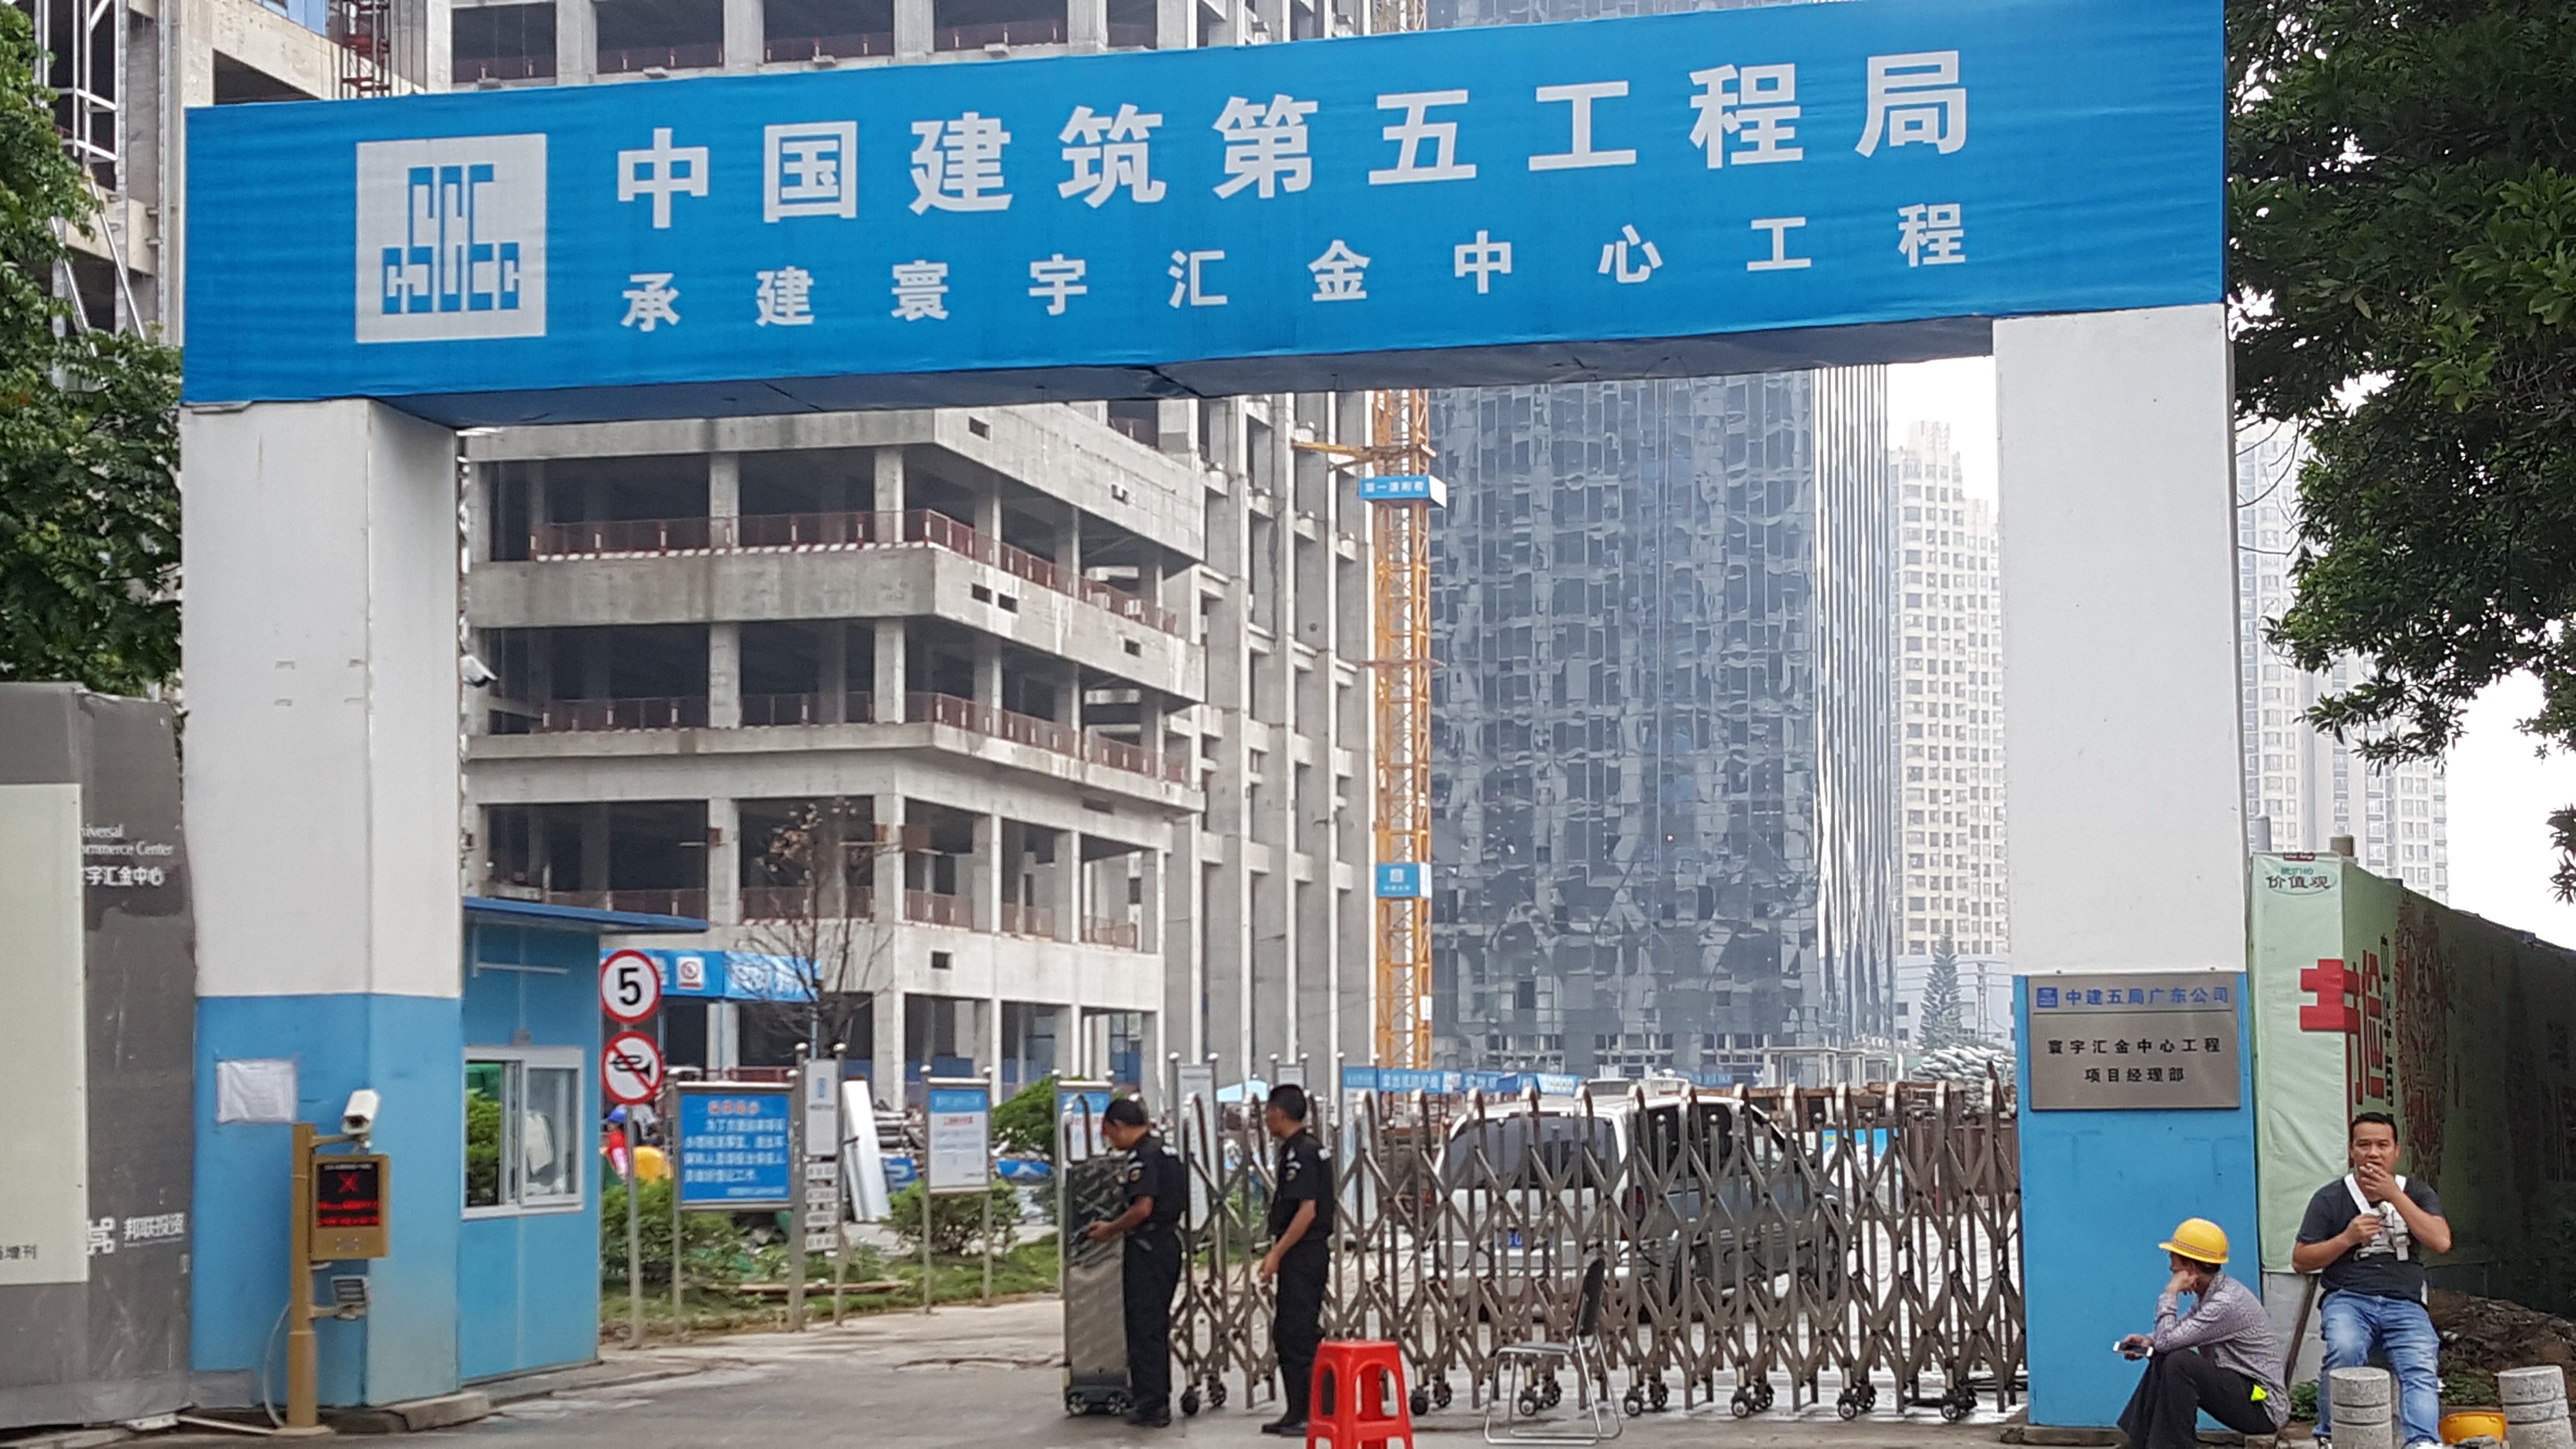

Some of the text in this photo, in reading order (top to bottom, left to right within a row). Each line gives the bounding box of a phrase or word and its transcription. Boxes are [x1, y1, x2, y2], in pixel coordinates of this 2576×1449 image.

[617, 50, 1967, 228] 中国建筑第五工程局
[620, 203, 1966, 332] 承建寰宇汇金中心工程
[81, 824, 124, 838] niversal
[81, 841, 173, 855] ommerce Center
[81, 866, 165, 886] 宇汇金中心
[2266, 874, 2331, 889] 价值观
[618, 967, 641, 1006] 5
[2065, 987, 2229, 1005] 中建五局广东公司
[2048, 1037, 2221, 1054] 寰宇汇金中心工程
[2085, 1067, 2185, 1082] 项目经理部
